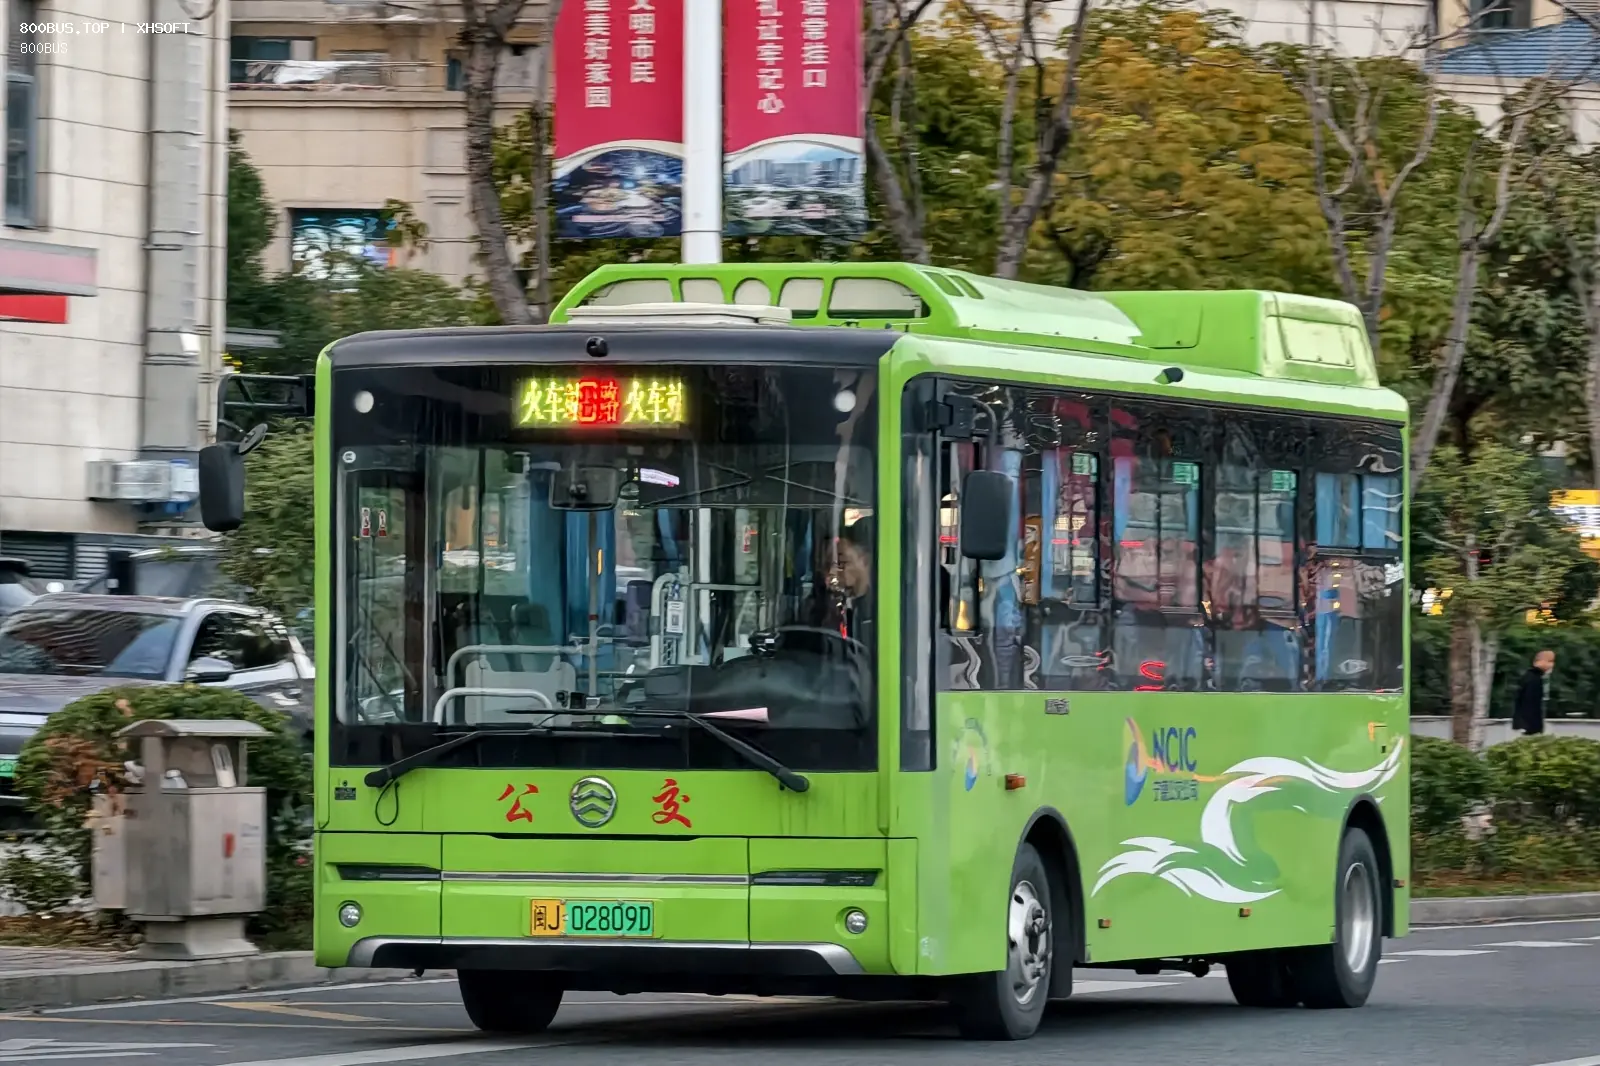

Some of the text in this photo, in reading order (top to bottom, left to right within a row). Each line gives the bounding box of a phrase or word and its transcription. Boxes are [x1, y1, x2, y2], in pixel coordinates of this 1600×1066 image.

[1152, 726, 1197, 772] NCIC
[497, 778, 692, 829] 公 交
[571, 904, 651, 932] 02809D
